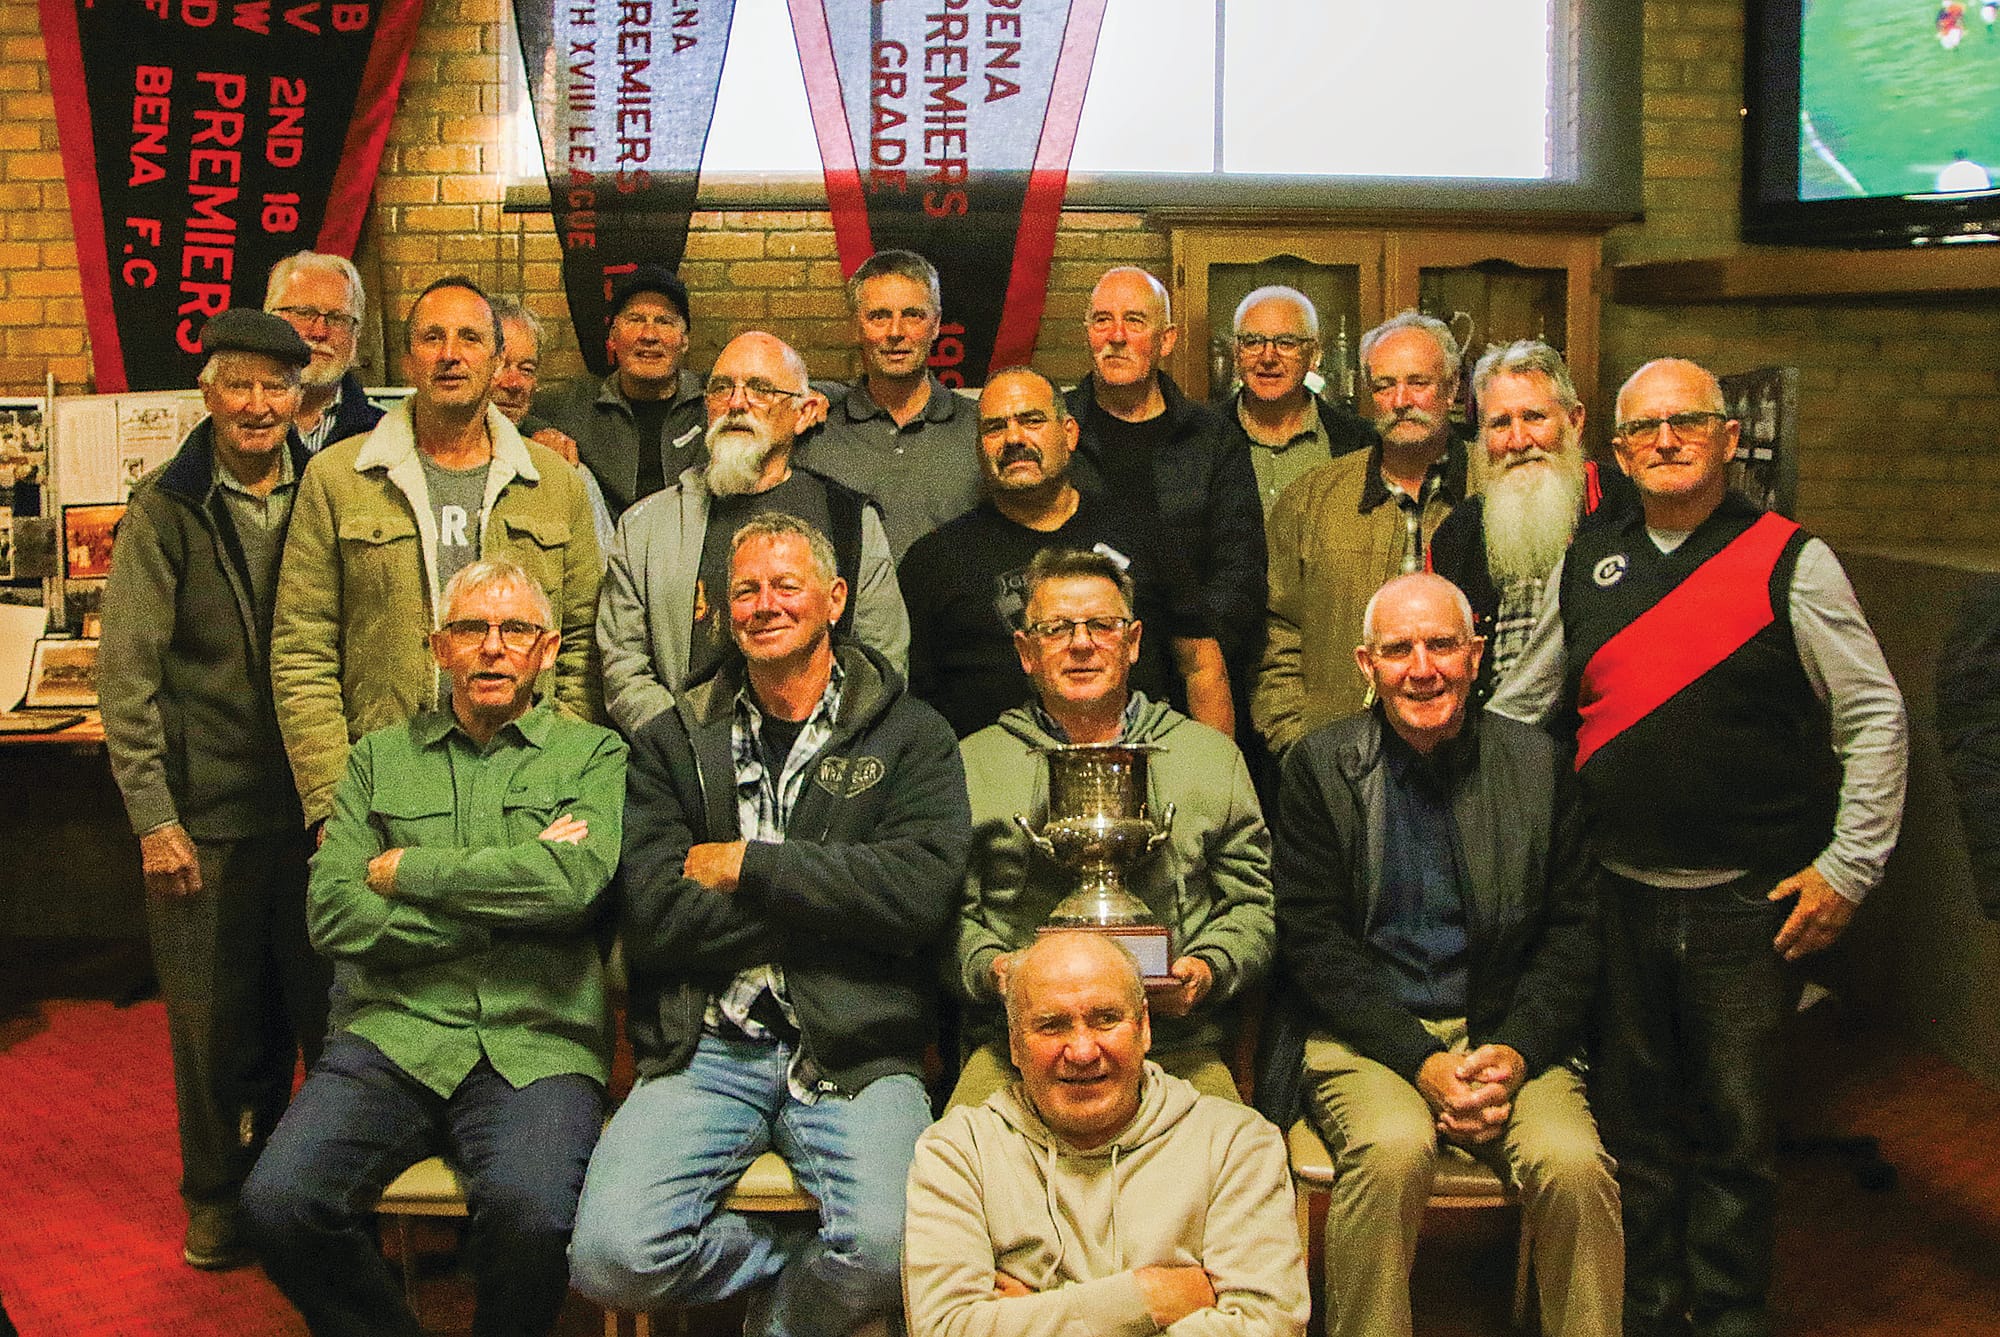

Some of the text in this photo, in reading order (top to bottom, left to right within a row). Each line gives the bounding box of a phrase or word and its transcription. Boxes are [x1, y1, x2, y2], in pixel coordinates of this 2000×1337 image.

[616, 0, 652, 193] REMIERS
[672, 0, 699, 54] NA
[127, 65, 173, 187] BENA
[261, 76, 307, 234] 2ND 18
[566, 0, 596, 249] H XVIII LEAGUE
[871, 40, 908, 194] GRADE
[122, 217, 162, 289] F.C
